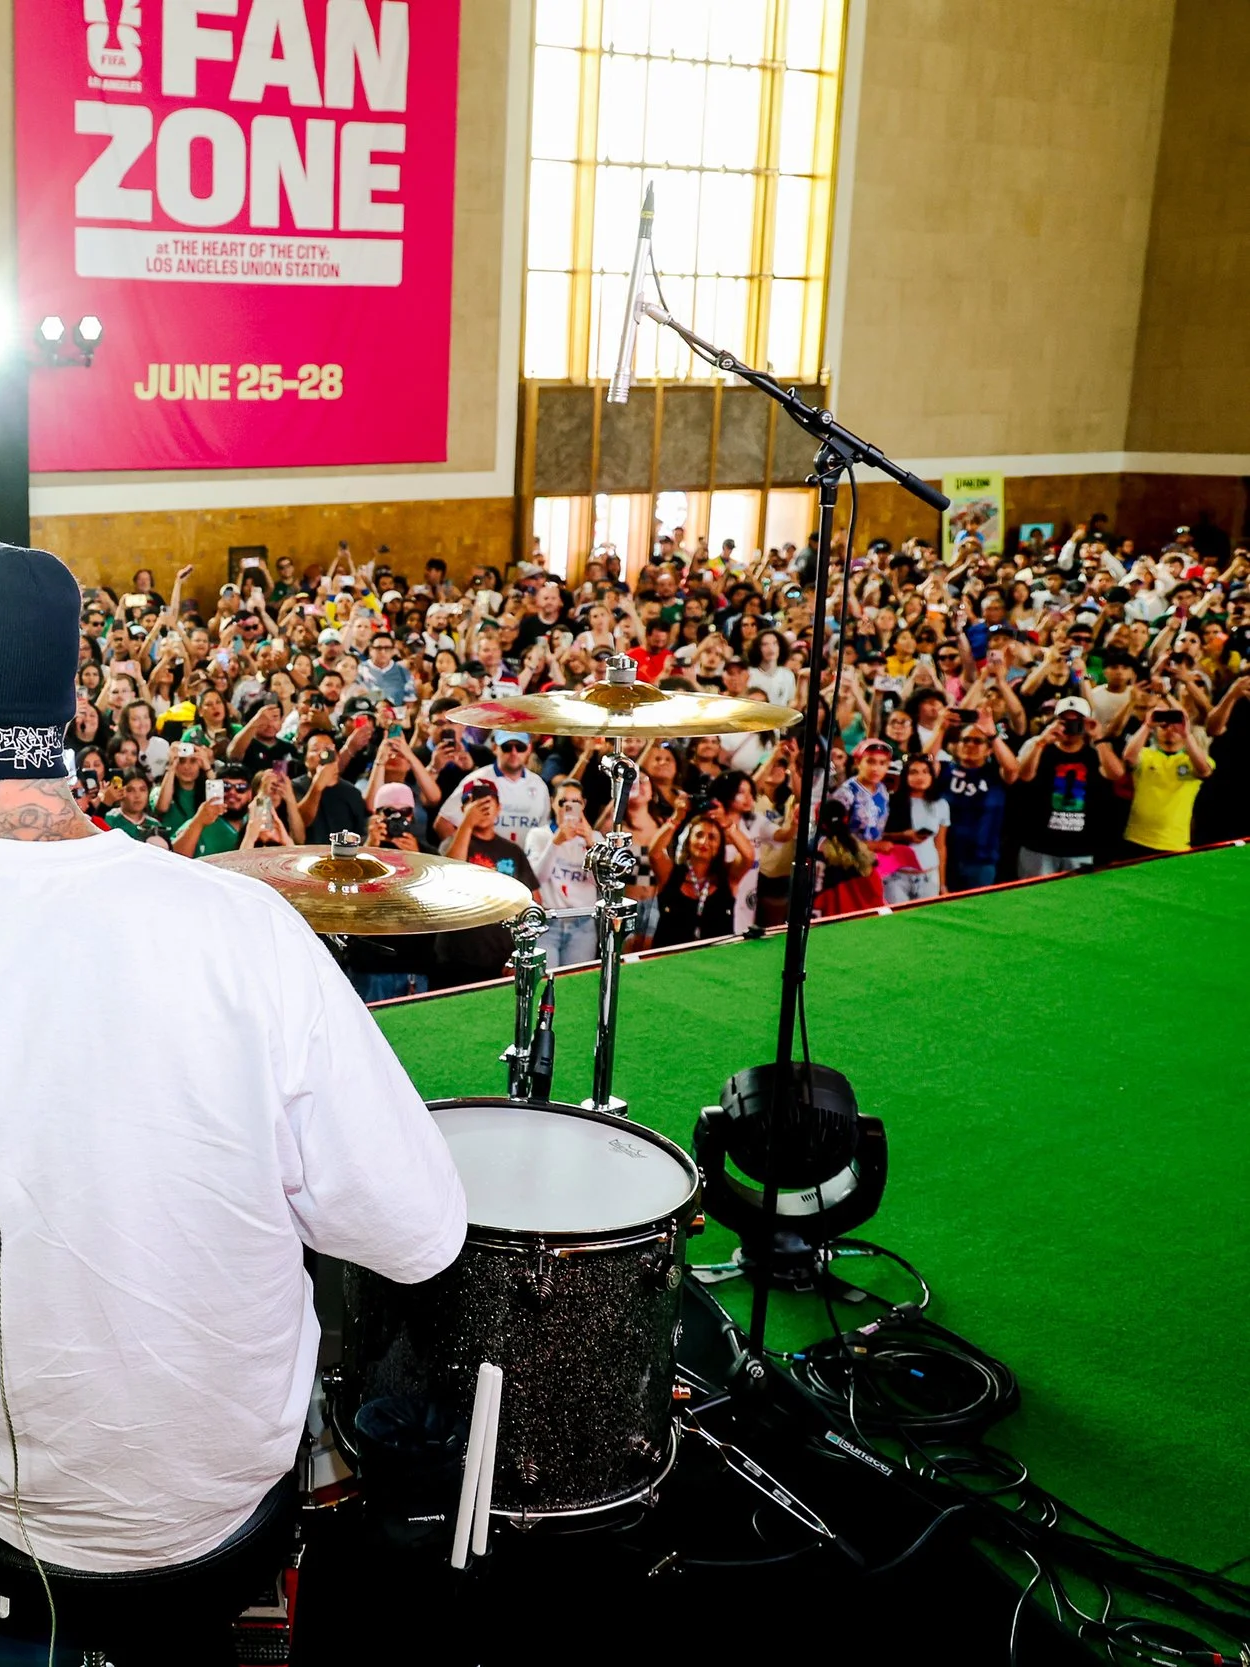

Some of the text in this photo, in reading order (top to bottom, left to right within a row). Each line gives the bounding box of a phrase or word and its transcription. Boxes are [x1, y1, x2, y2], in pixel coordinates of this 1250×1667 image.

[101, 55, 127, 66] FIFA
[161, 0, 409, 112] FAN
[74, 100, 406, 232] ZONE
[156, 240, 330, 260] at THE HEART OF THE CITY:
[146, 257, 340, 278] LOS ANGELES UNION STATION
[134, 363, 344, 400] JUNE 25-28
